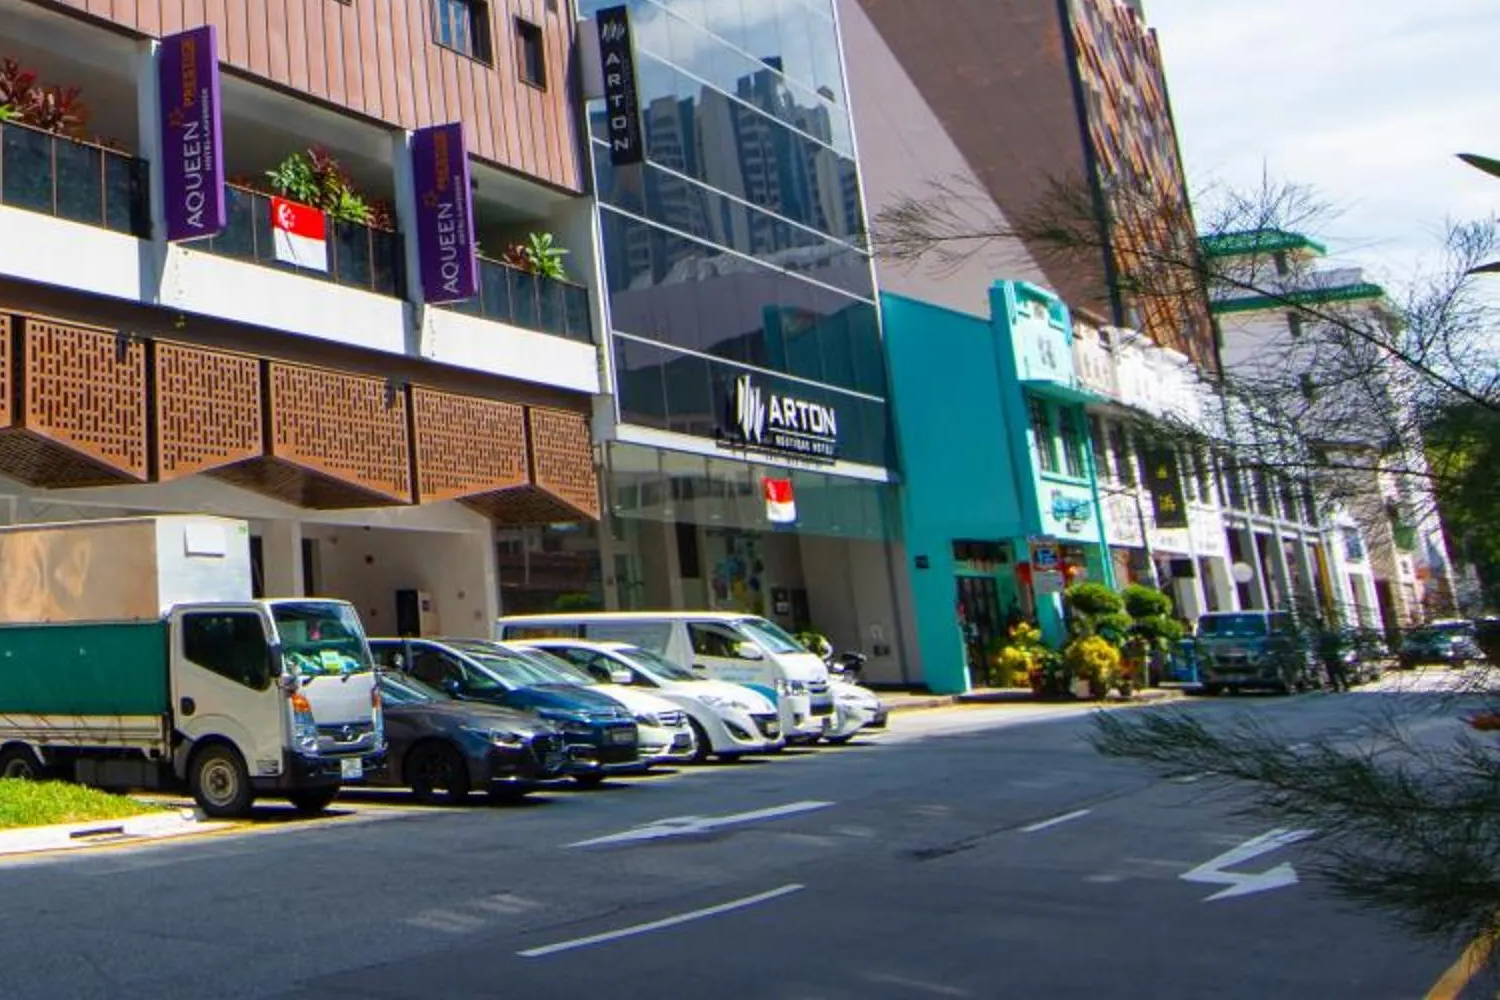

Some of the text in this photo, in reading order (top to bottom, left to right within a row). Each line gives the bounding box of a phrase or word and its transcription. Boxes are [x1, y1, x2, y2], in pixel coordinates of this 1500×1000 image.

[606, 52, 629, 151] ARTON
[183, 121, 205, 228] AQUEEN
[437, 203, 460, 294] AQUEEN
[770, 394, 837, 435] ARTON
